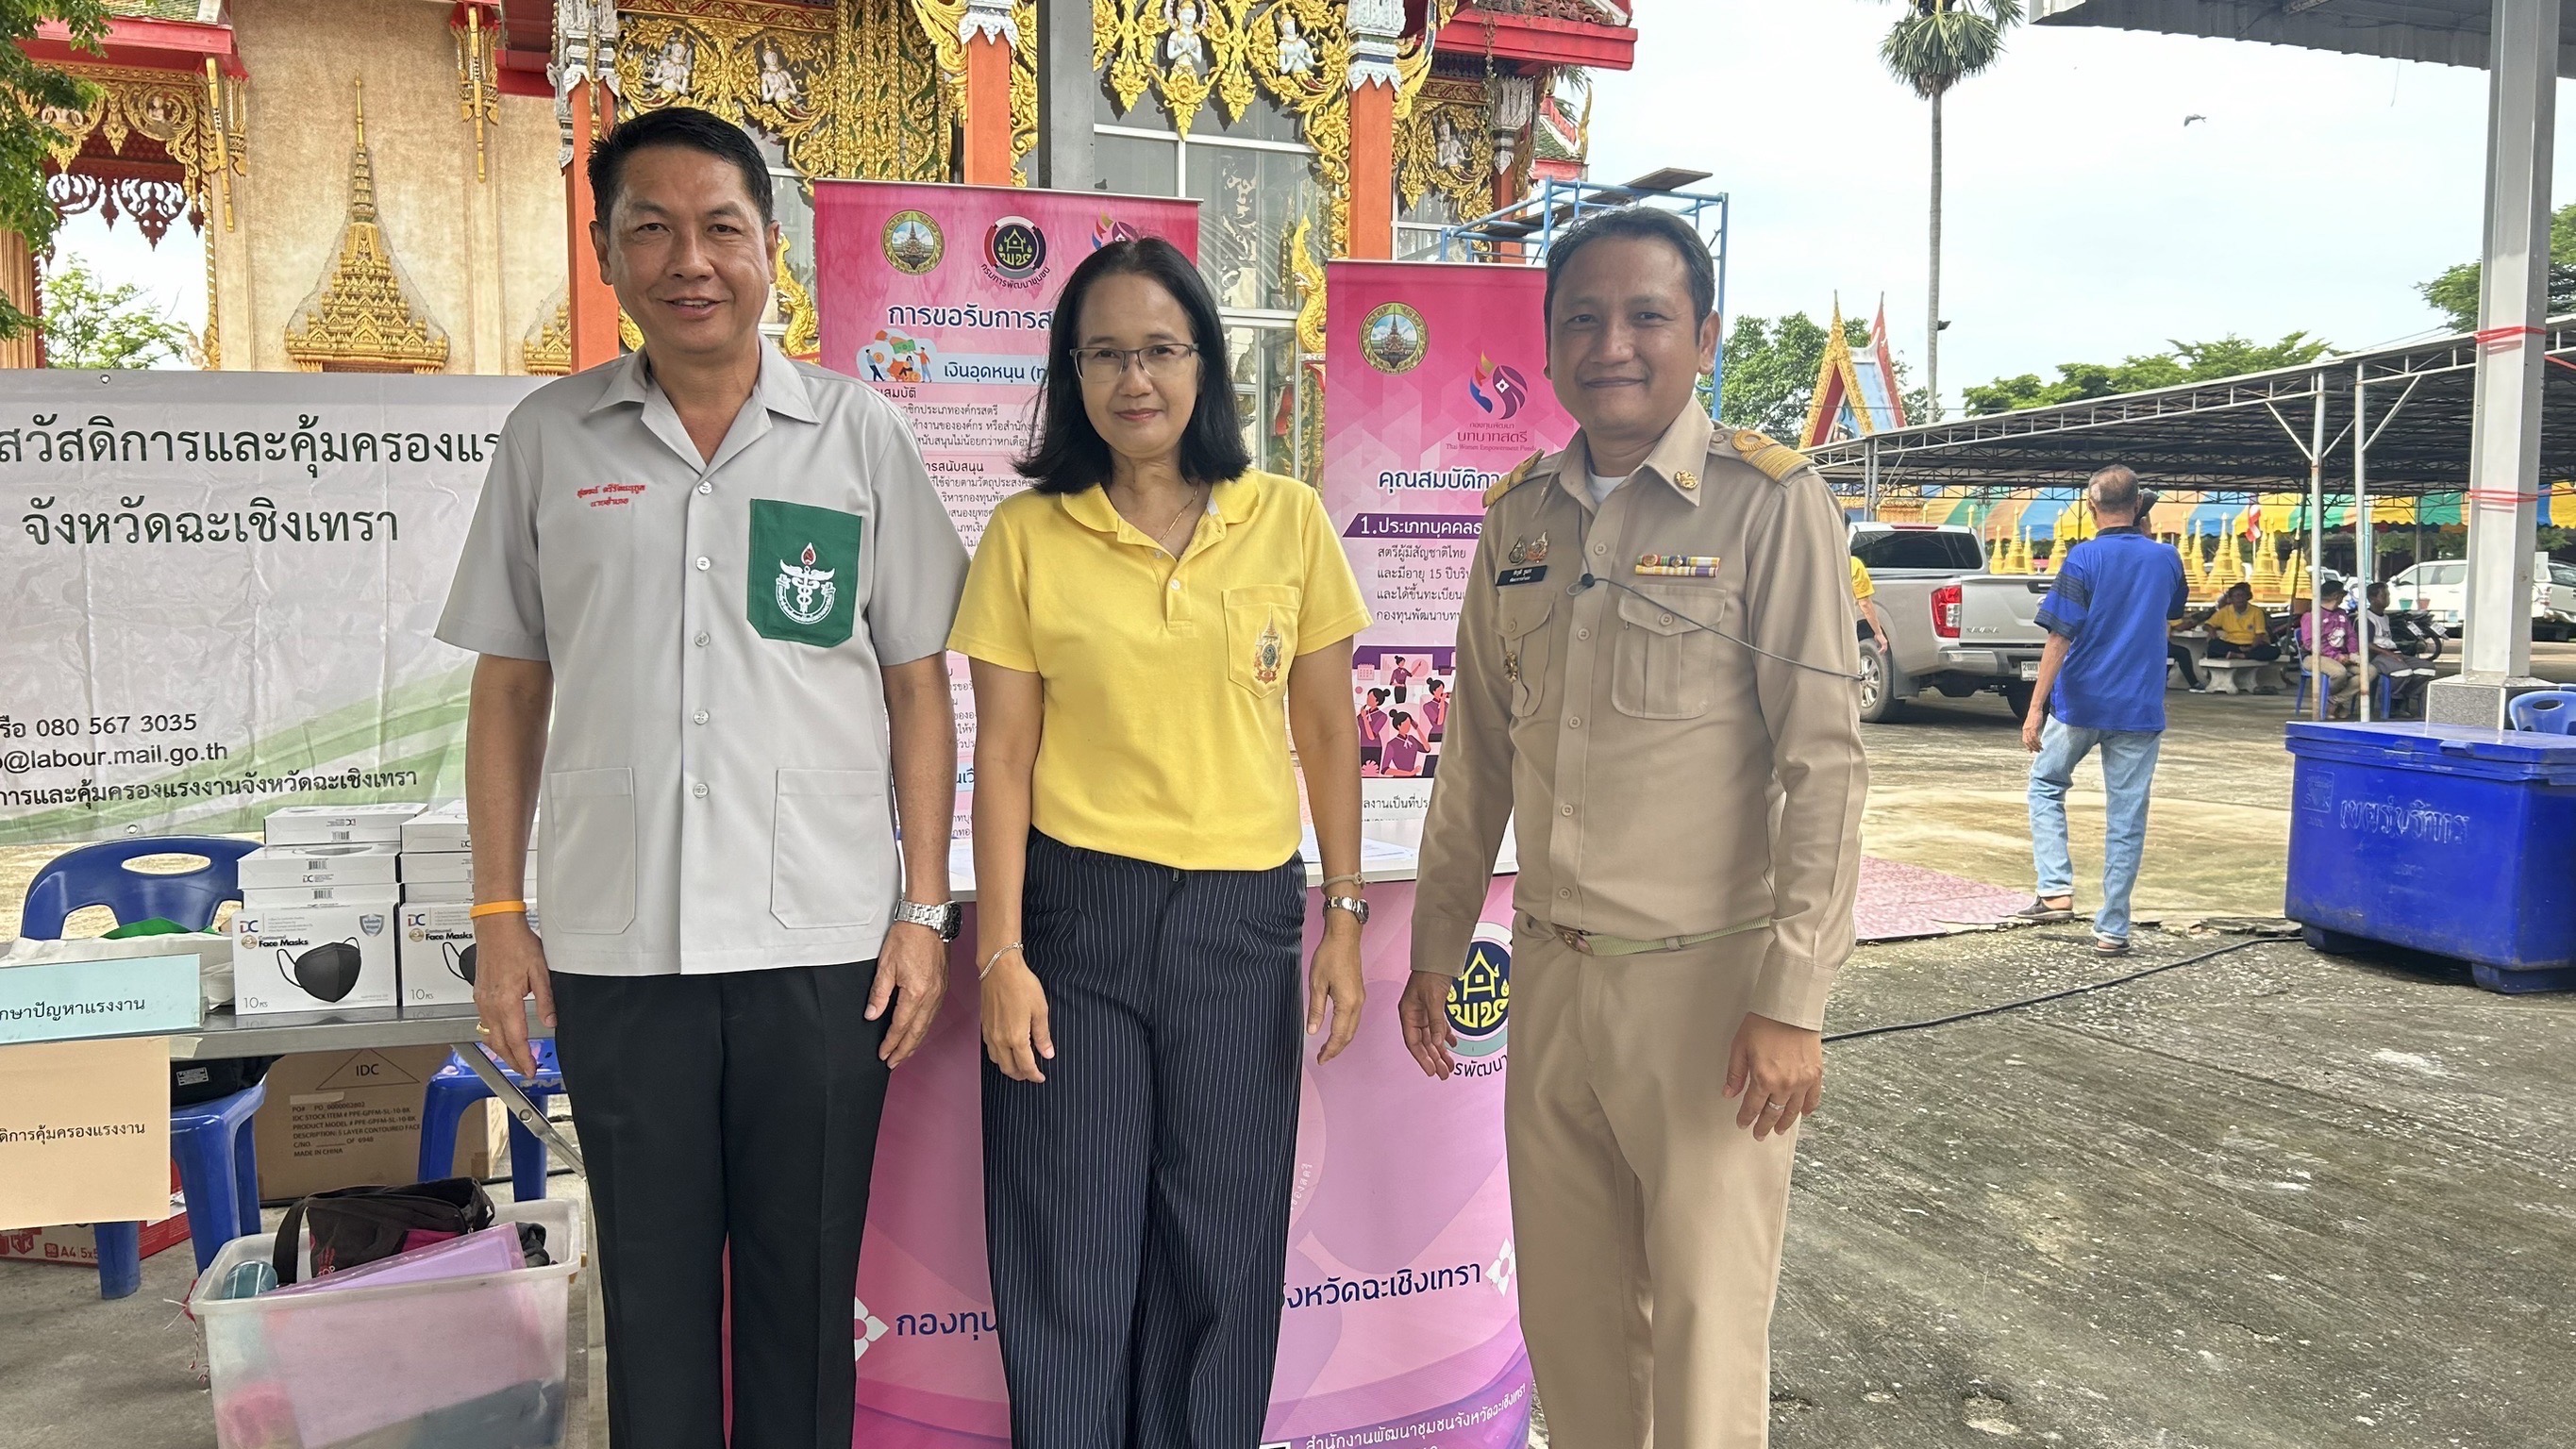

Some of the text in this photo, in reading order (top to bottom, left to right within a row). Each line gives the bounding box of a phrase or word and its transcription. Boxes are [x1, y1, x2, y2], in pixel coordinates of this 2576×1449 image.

[980, 263, 1051, 290] กรมการพัฒนาชุมชน
[945, 361, 1025, 383] เงินอุดหนุน
[1457, 430, 1528, 442] บทบาทสตรี
[21, 496, 399, 545] จังหวัดฉะเชิงเทรา
[1378, 543, 1466, 562] สตรีผู้มีสัญชาติไทย
[1378, 565, 1425, 583] และมีอายุ
[1430, 569, 1442, 579] 15
[36, 718, 80, 737] 080
[89, 716, 131, 735] 567
[140, 713, 197, 733] 3035
[0, 742, 228, 774] @labour.mail.go.th
[259, 940, 278, 948] Face
[279, 938, 309, 947] Masks
[445, 930, 473, 940] Masks
[356, 1064, 379, 1076] IDC
[364, 1125, 404, 1134] CONTOURED
[61, 1247, 76, 1257] A4
